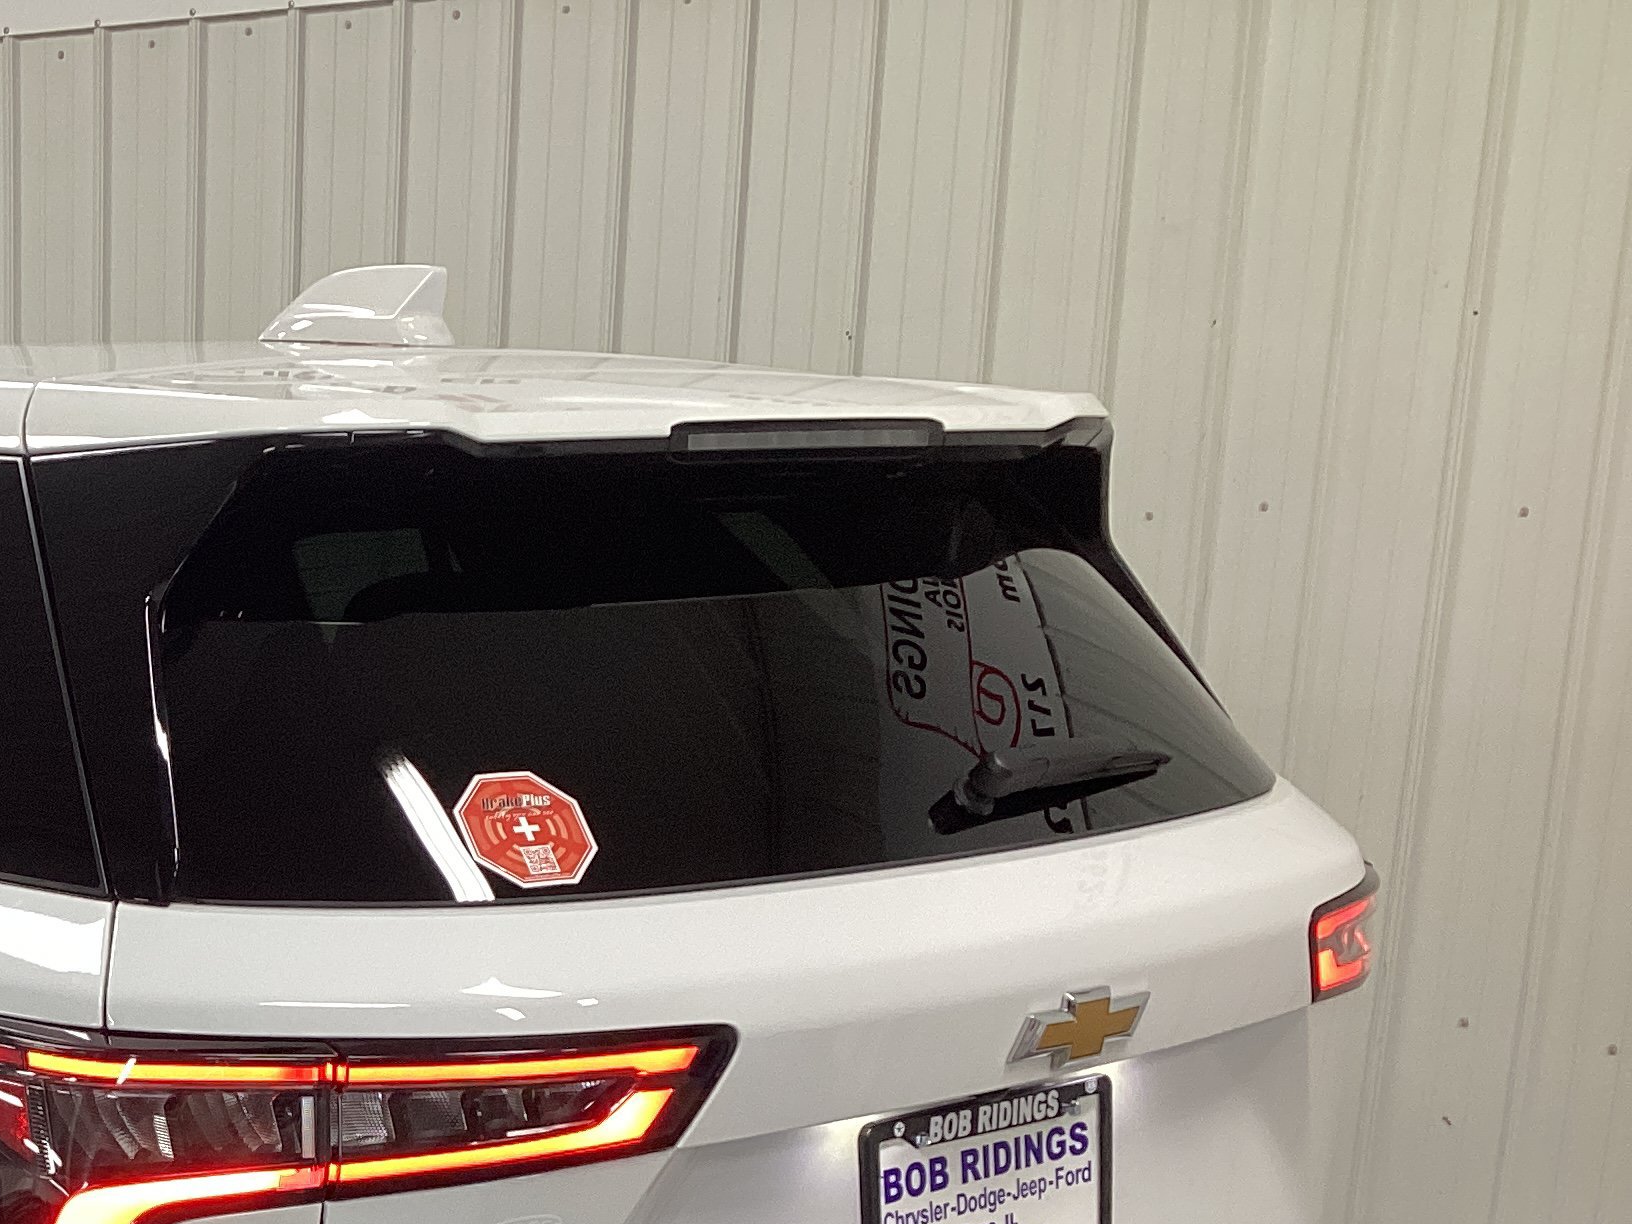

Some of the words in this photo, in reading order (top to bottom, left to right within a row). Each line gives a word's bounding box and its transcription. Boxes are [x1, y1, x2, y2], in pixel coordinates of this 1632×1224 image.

[929, 1108, 972, 1144] BOB
[977, 1088, 1060, 1134] RIDINGS
[882, 1155, 950, 1205] BOB
[961, 1121, 1090, 1185] RIDINGS
